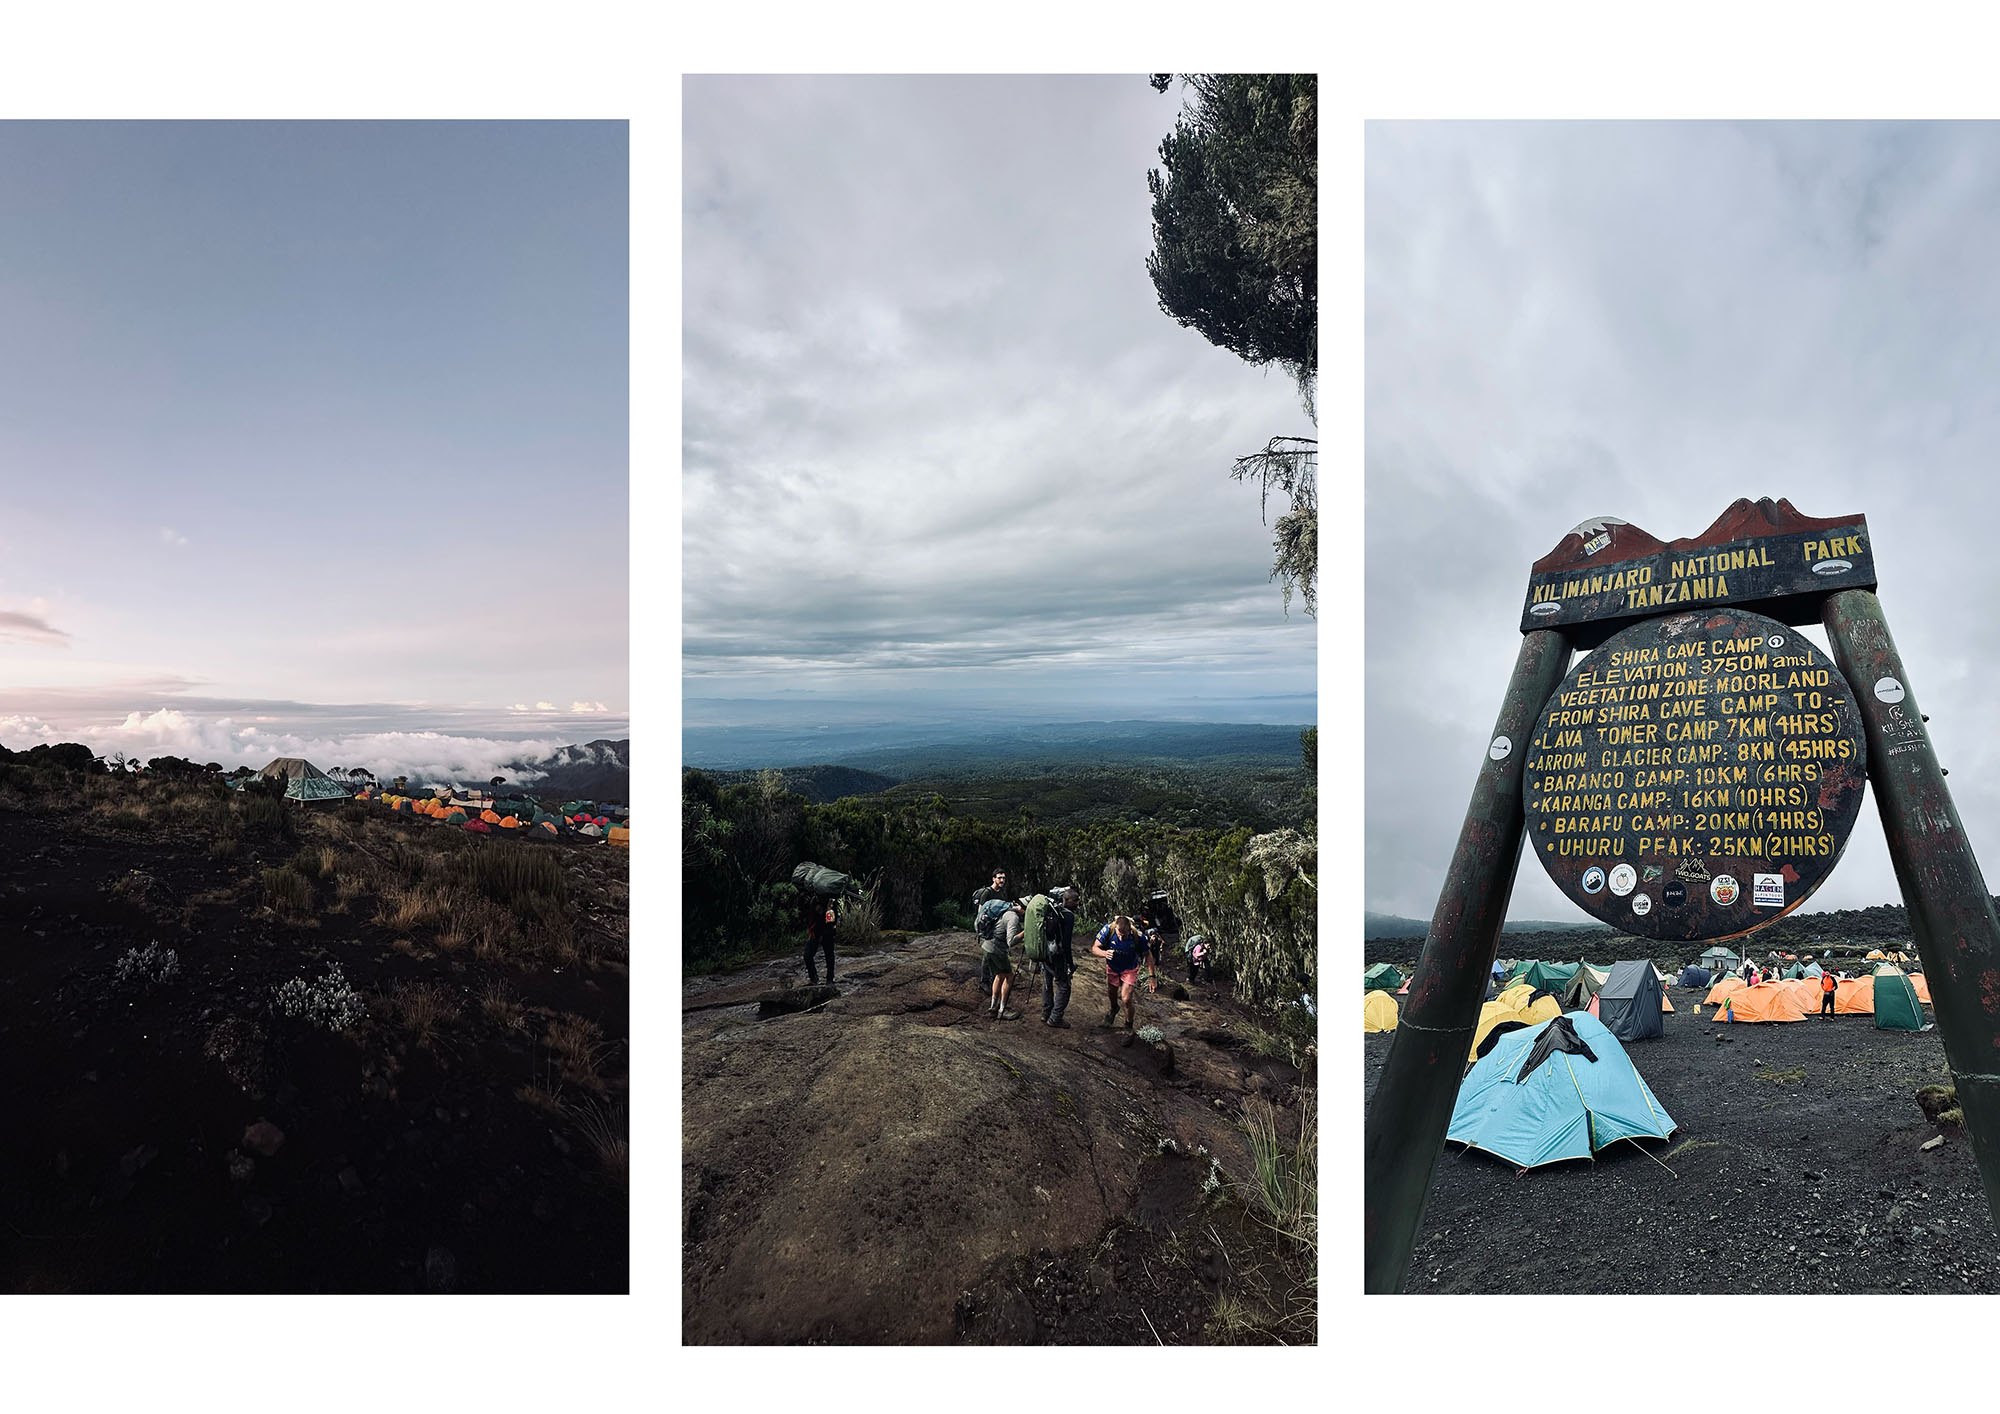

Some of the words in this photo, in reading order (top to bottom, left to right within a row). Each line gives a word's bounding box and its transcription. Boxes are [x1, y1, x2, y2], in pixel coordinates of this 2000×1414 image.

[1533, 567, 1651, 603] KILIMANJARO
[1672, 548, 1775, 579] NATIONAL
[1803, 536, 1863, 561] PARK
[1628, 576, 1729, 609] TANZANIA
[1611, 647, 1659, 667] SHIRA
[1667, 641, 1706, 659] CAVE
[1712, 636, 1763, 654] CAMP
[1577, 663, 1692, 688] ELEVATION:
[1700, 656, 1768, 675] 3750M
[1772, 651, 1813, 668] amsl
[1560, 684, 1659, 707] VEGETATION
[1716, 669, 1829, 693] MOORLAND
[1548, 711, 1593, 727] FROM
[1597, 704, 1651, 723] SHIRA
[1660, 699, 1706, 718] CAVE
[1721, 695, 1778, 714] CAMP
[1596, 724, 1657, 744] TOWER
[1666, 721, 1719, 741] CAMP
[1602, 747, 1677, 767] GLACIER
[1679, 746, 1728, 764] CAMP:
[1635, 769, 1690, 788] CAMP:
[1696, 767, 1747, 785] 10KM
[1756, 761, 1823, 784] (6HRS)
[1618, 791, 1672, 809] CAMP:
[1632, 814, 1690, 832] CAMP:
